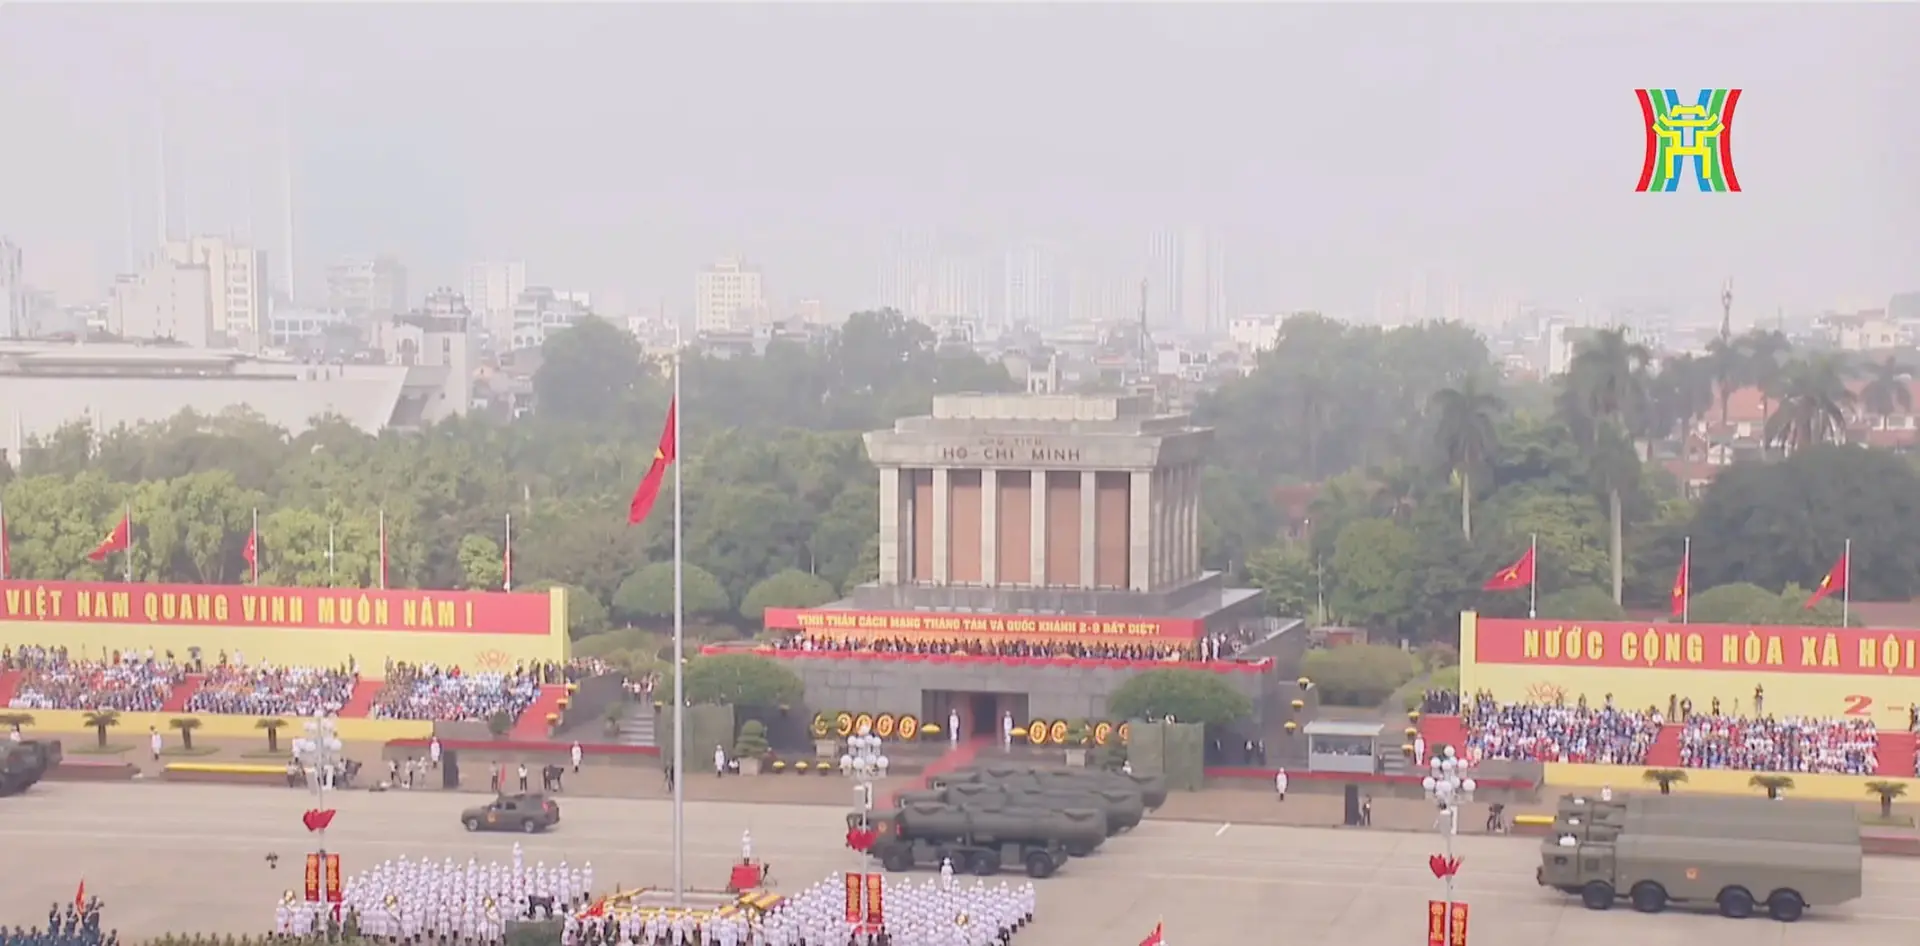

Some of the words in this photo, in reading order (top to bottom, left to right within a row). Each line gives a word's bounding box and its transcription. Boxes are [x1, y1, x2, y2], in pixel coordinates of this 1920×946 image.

[6, 585, 62, 620] VIỆT
[77, 591, 130, 618] NAM
[143, 592, 229, 621] QUANG
[242, 595, 303, 623] VINH
[318, 593, 388, 625] MUÔN
[403, 597, 455, 627] NĂM
[1523, 625, 1603, 660] NƯỚC
[1621, 627, 1704, 667] CỘNG
[1722, 630, 1784, 665] HÒA
[1801, 632, 1840, 666] XÃ
[1858, 633, 1917, 674] HỘI
